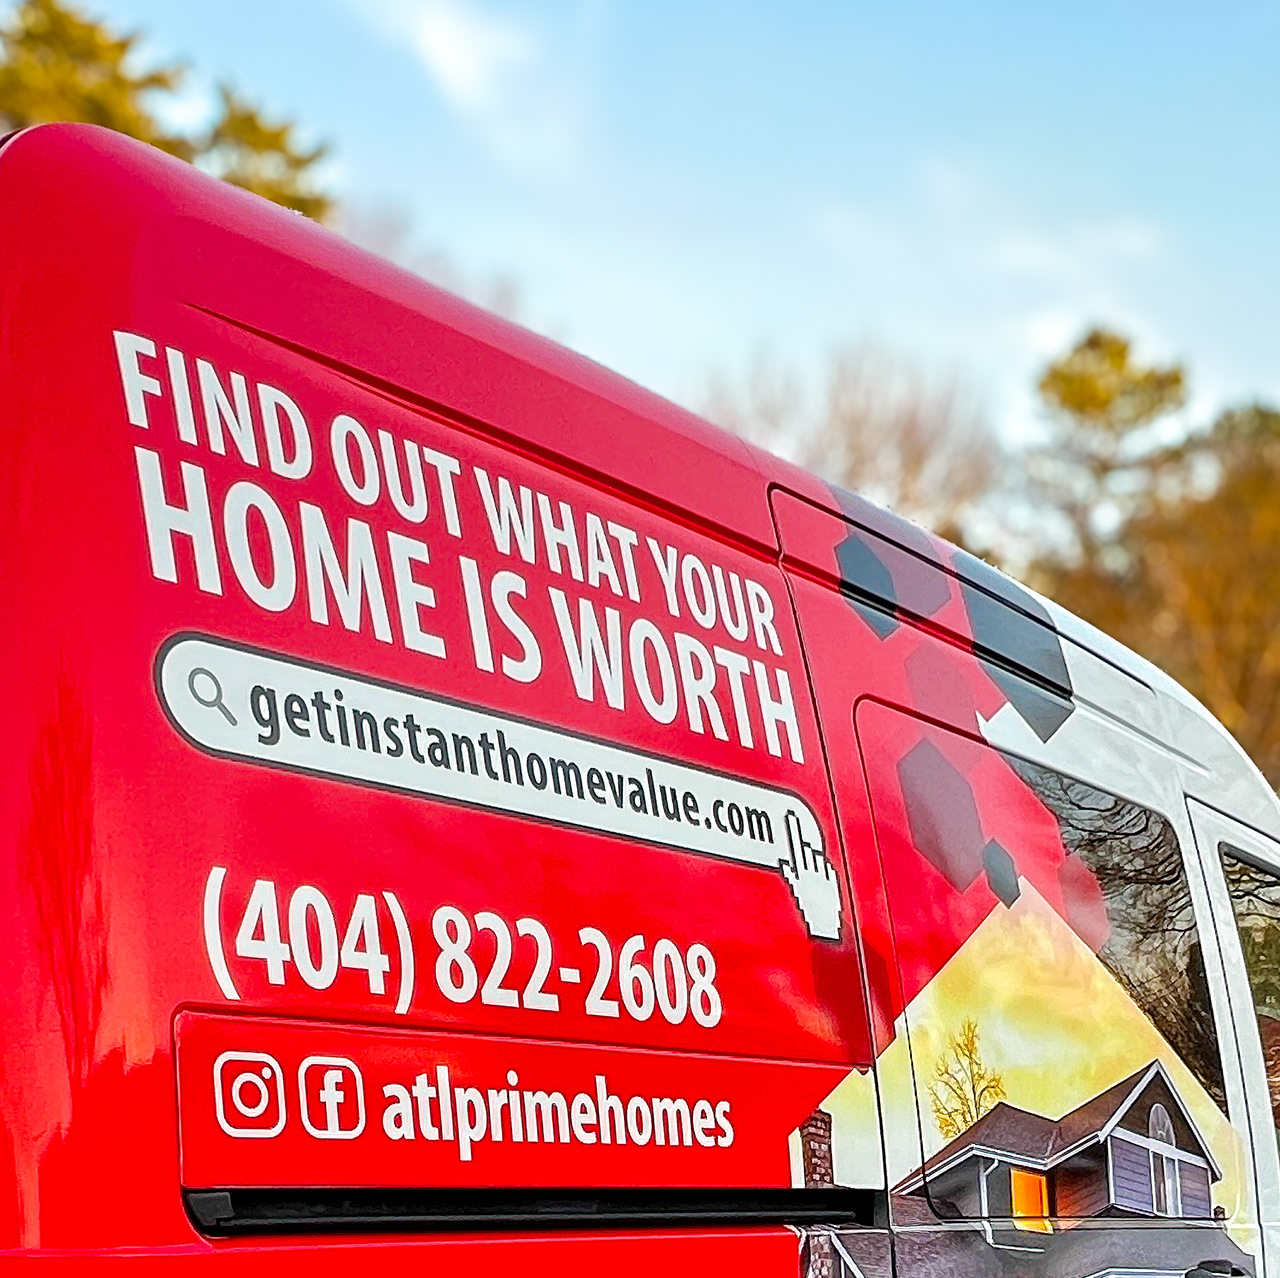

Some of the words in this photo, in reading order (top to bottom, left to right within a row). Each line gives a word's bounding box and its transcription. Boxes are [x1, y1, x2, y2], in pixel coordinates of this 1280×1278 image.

[112, 330, 313, 480] FIND
[329, 414, 460, 538] OUT
[474, 467, 641, 603] WHAT
[642, 537, 783, 655] YOUR
[133, 446, 446, 659] HOME
[459, 554, 543, 683] IS
[549, 587, 805, 764] WORTH
[250, 678, 775, 844] getinstanthomevalue.com
[203, 867, 415, 1014] (404)
[431, 906, 721, 1029] 822-2608
[382, 1064, 734, 1161] atlprimehomes
